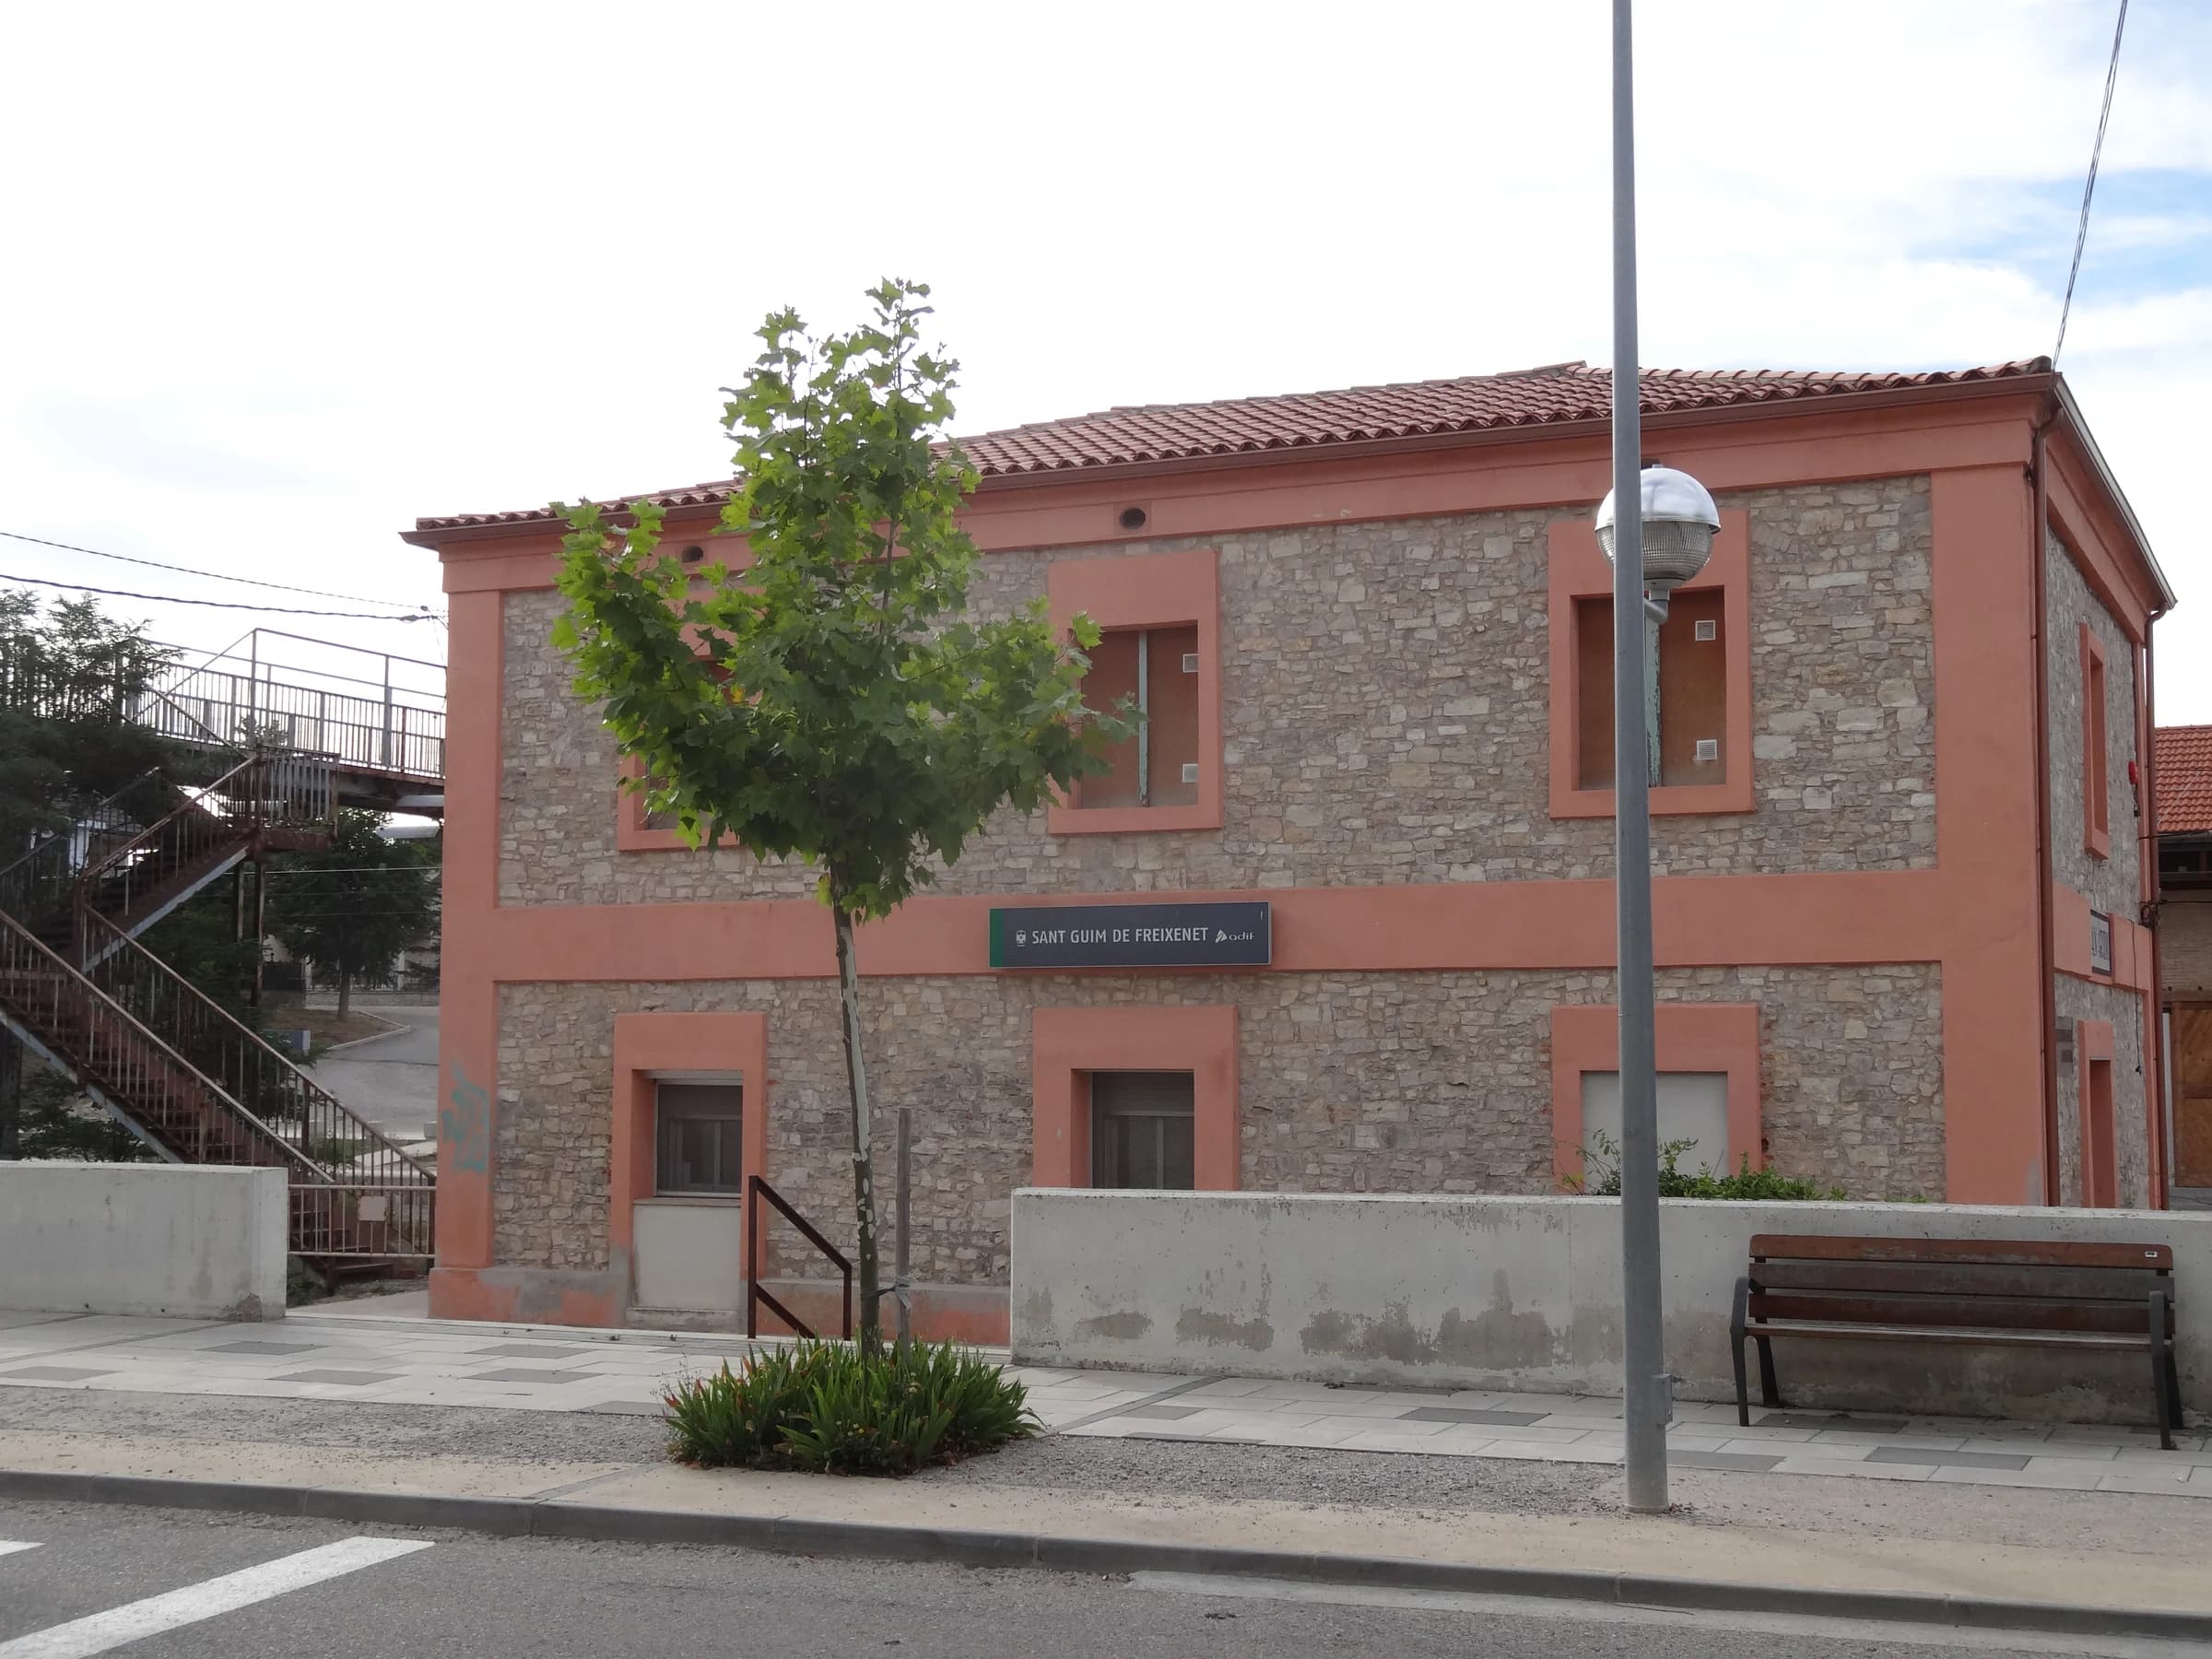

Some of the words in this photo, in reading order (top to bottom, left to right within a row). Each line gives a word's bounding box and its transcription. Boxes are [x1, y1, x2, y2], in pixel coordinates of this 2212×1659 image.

[1031, 929, 1066, 945] SANT
[1070, 929, 1107, 944] GUIM
[1112, 928, 1130, 943] DE
[1135, 927, 1209, 943] FREIXENET
[1229, 931, 1254, 941] adif
